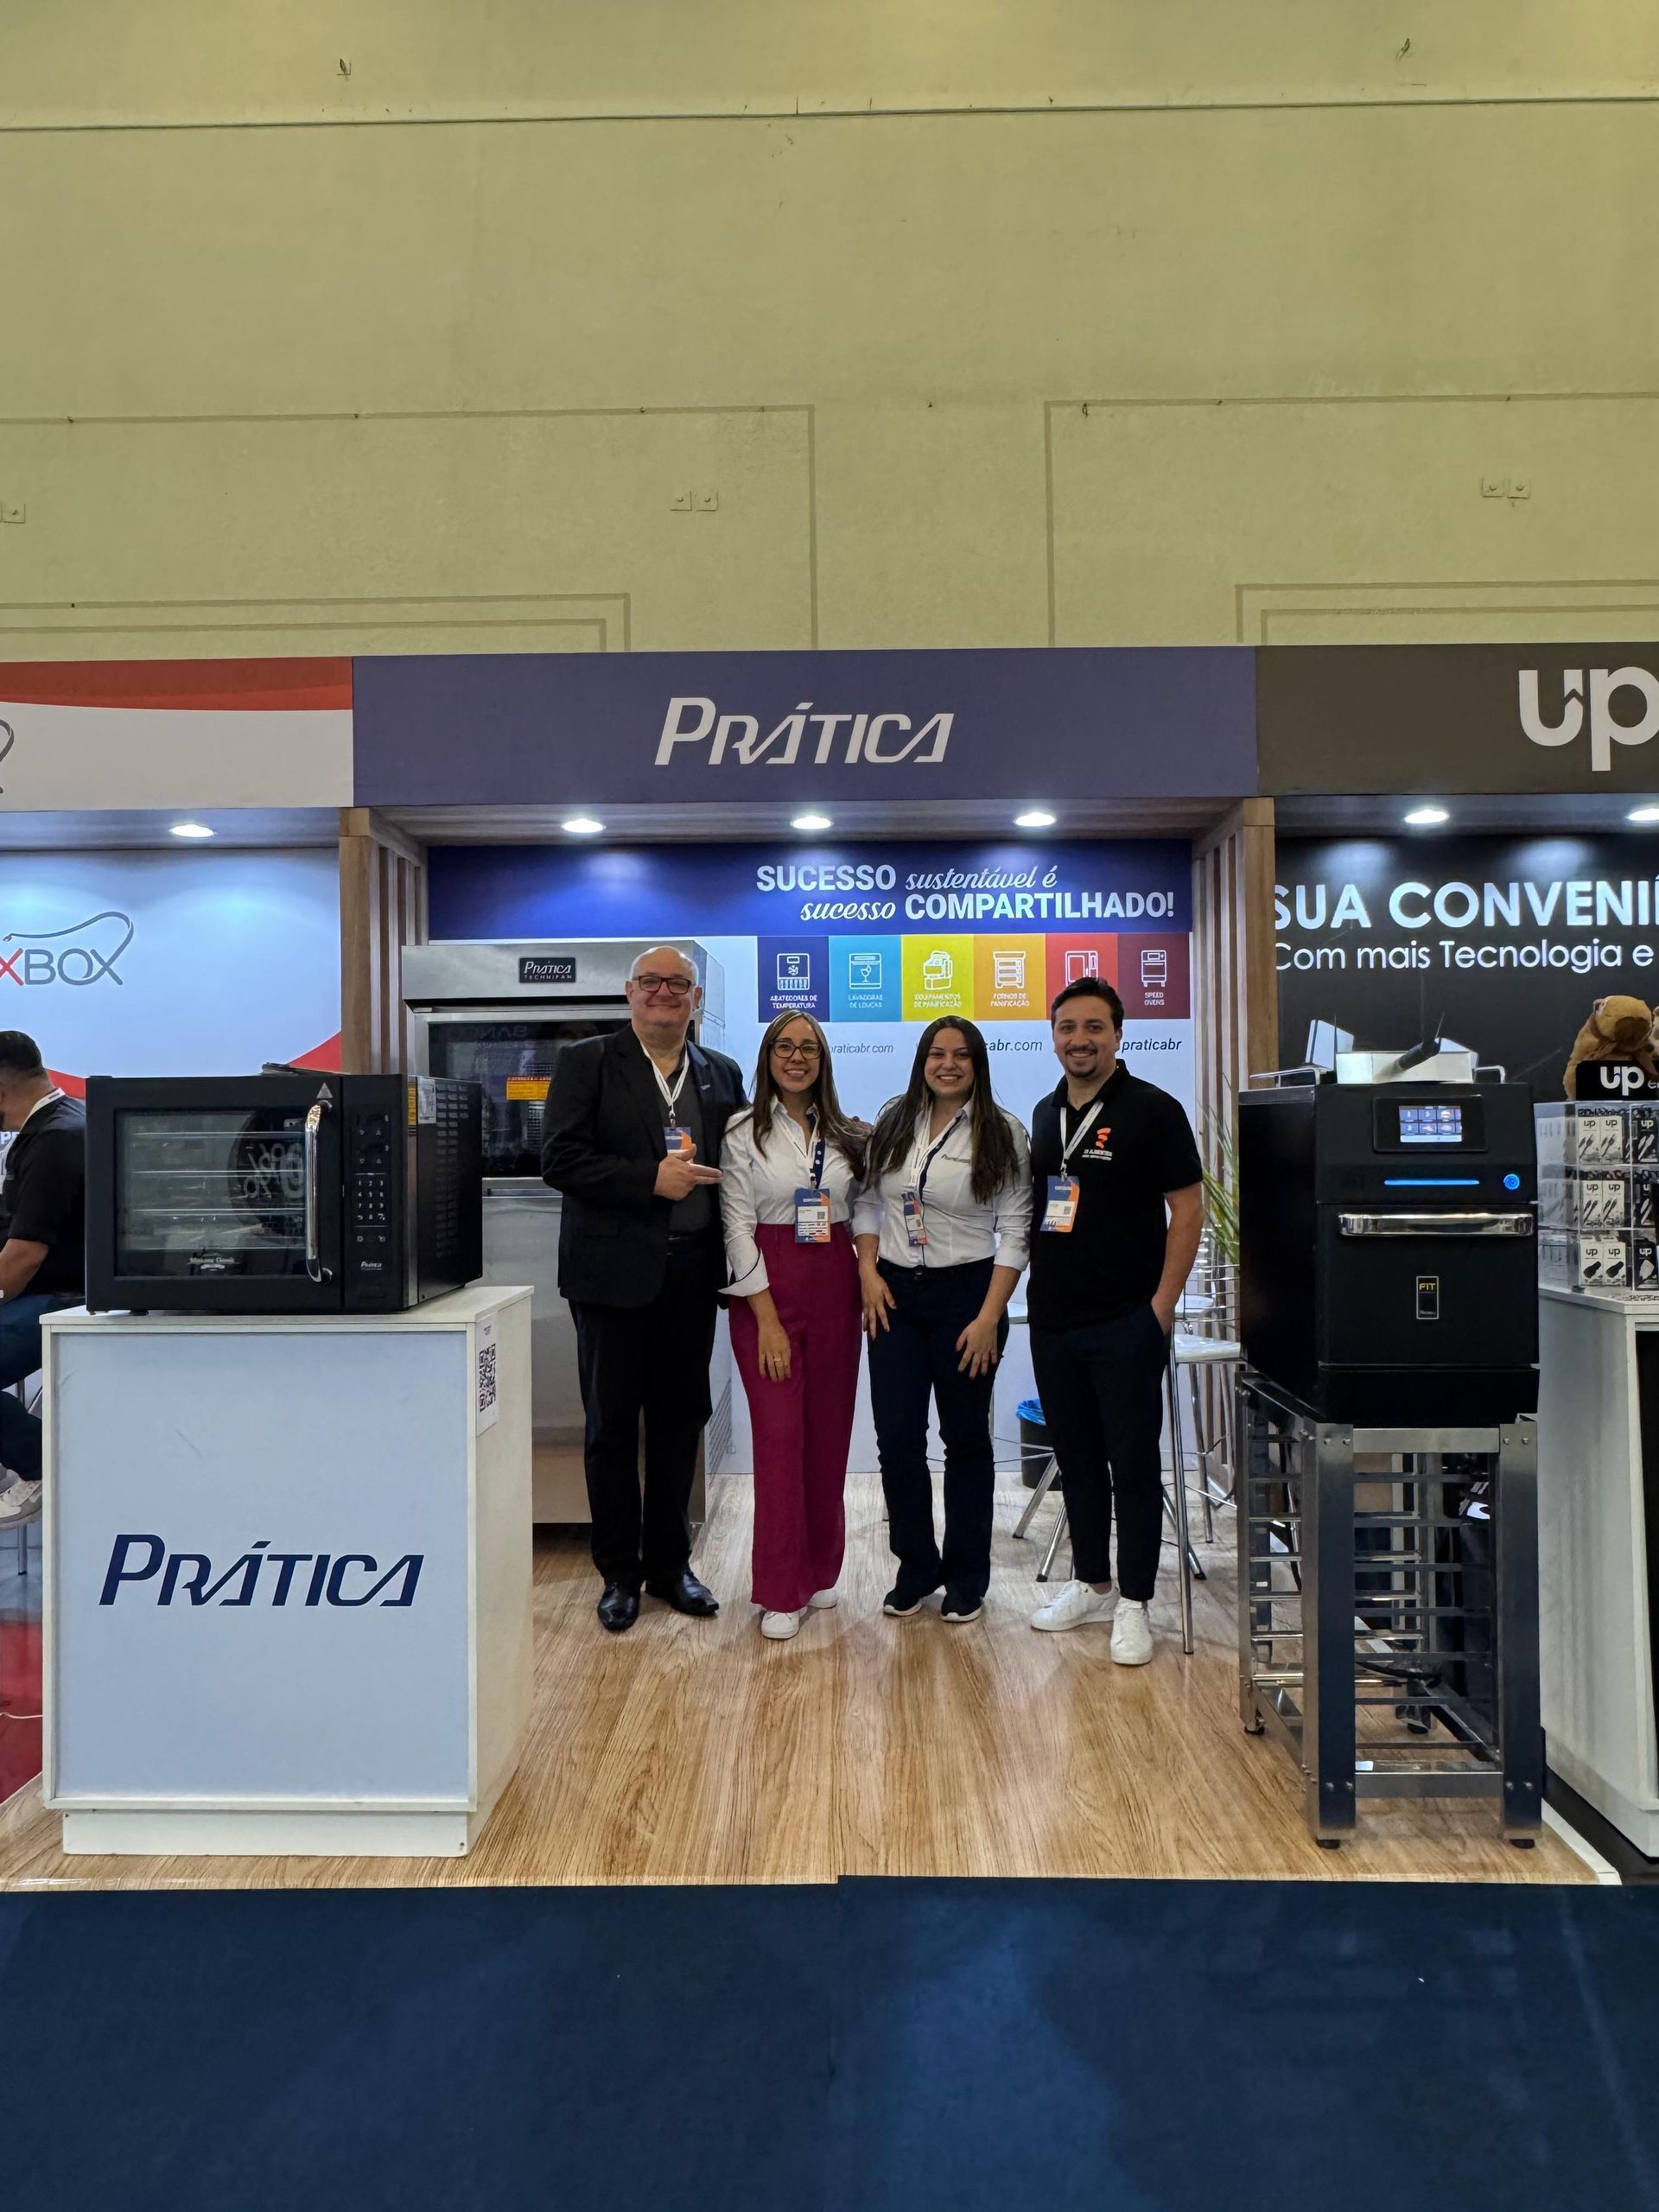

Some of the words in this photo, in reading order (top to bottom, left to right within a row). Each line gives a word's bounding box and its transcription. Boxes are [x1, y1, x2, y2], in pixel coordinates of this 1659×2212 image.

[1518, 666, 1659, 772] up
[756, 865, 896, 891] SUCESSO
[905, 865, 1038, 891] sustentável
[1042, 865, 1058, 888] é
[800, 901, 896, 921] sucesso
[905, 892, 1174, 920] COMPARTILHADO!
[1274, 884, 1372, 930] SUA
[1389, 874, 1659, 929] CONVENI
[1275, 942, 1345, 970] Com
[1357, 940, 1431, 969] mais
[1440, 938, 1622, 974] Tecnologia
[1632, 944, 1654, 967] e
[1122, 1038, 1182, 1053] praticabr
[1600, 1066, 1645, 1096] up
[1419, 1282, 1436, 1291] FIT
